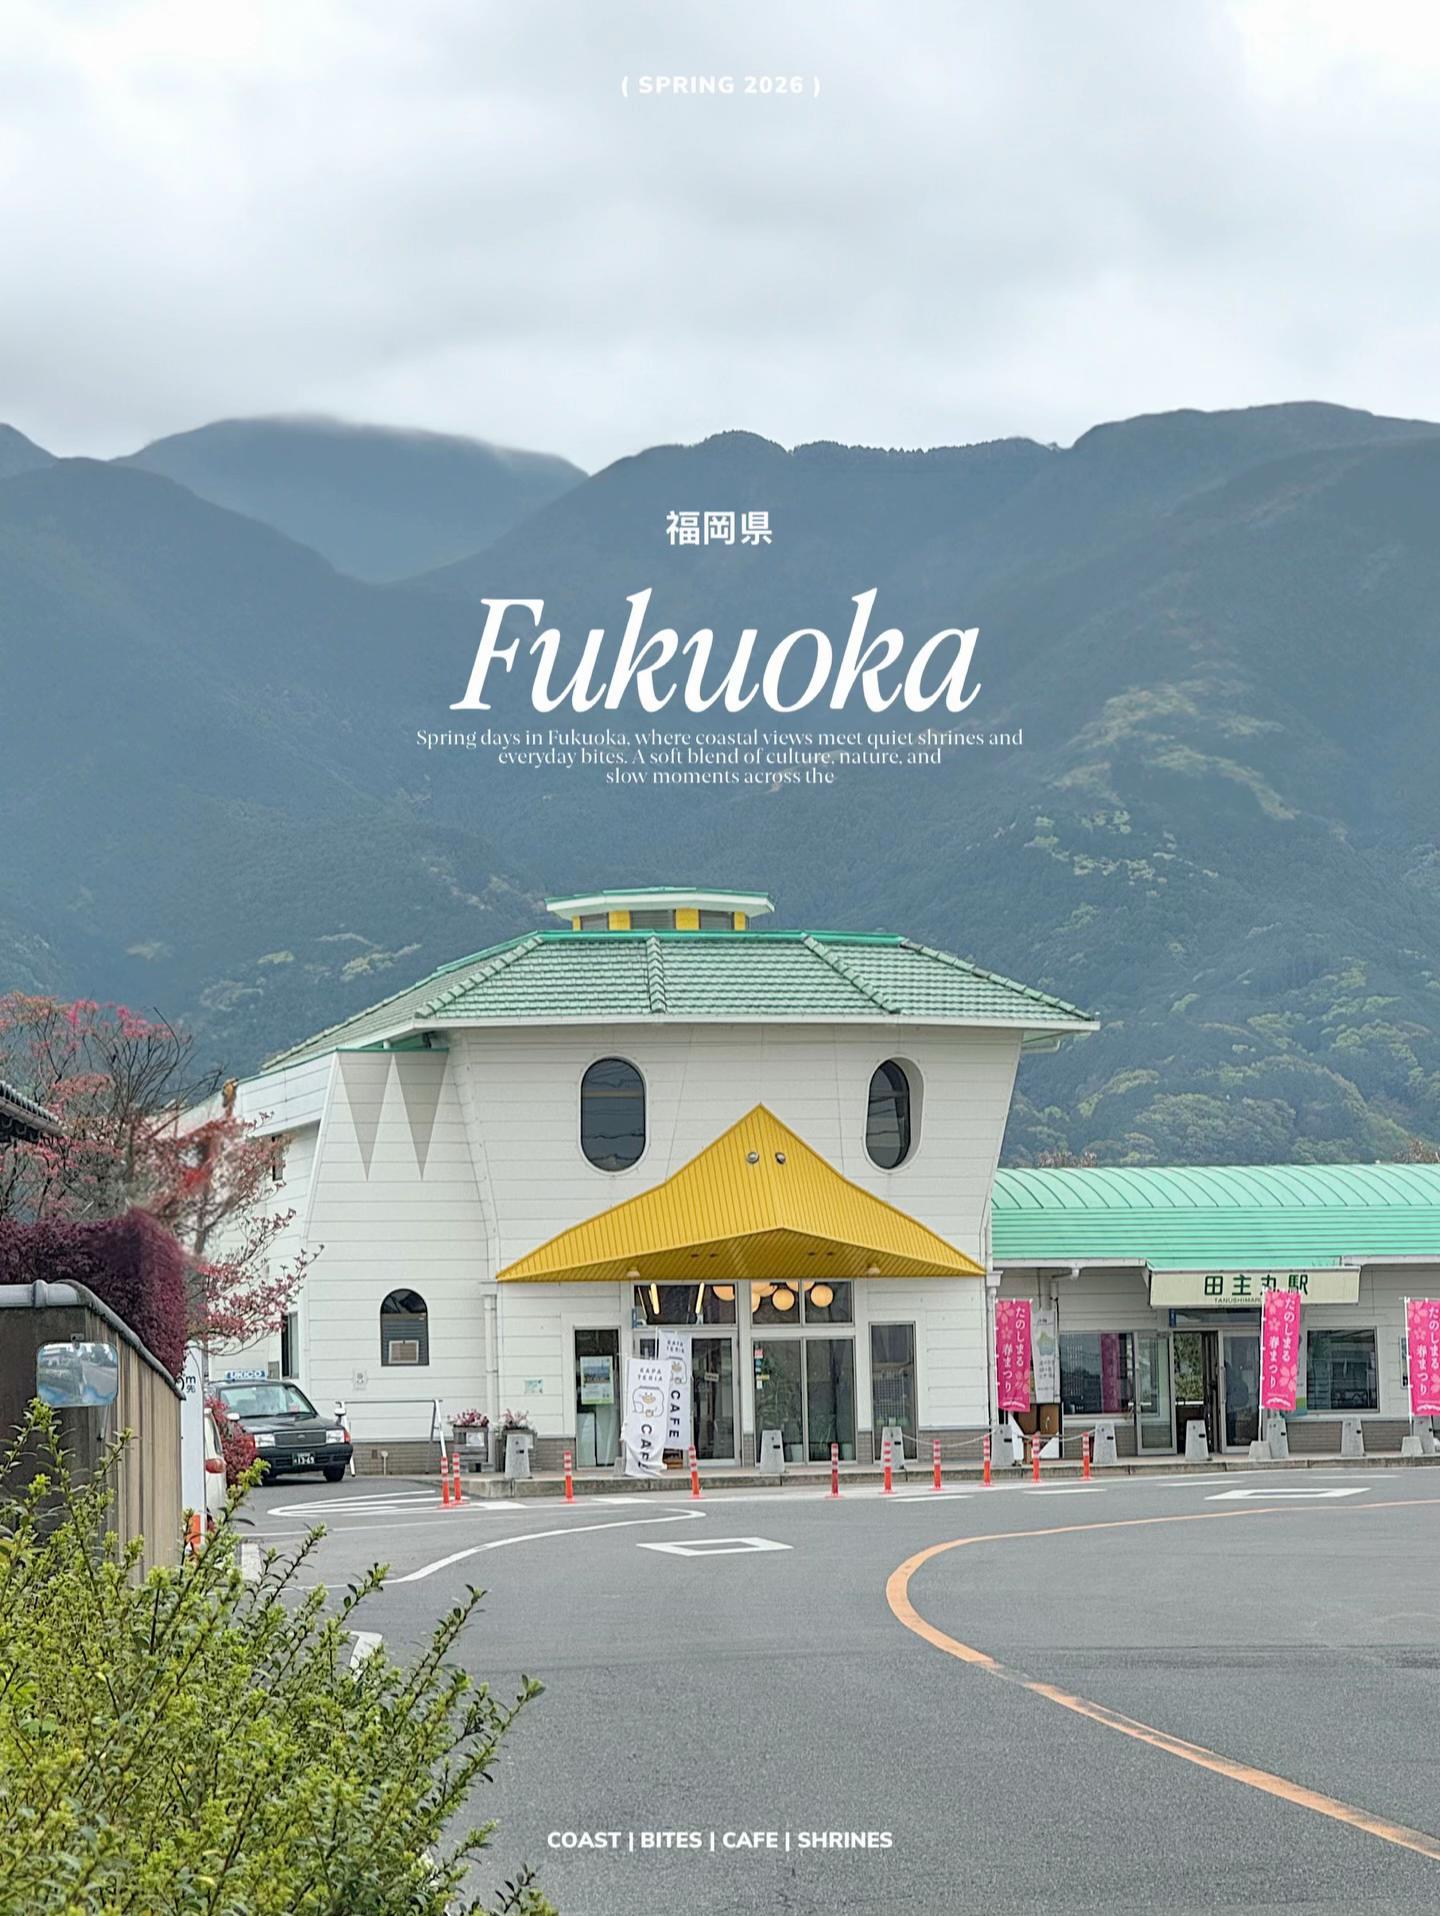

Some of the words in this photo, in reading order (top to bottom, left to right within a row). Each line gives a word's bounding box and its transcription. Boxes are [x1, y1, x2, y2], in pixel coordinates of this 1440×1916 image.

[1204, 1274, 1309, 1296] 田主丸駅
[1015, 1306, 1026, 1367] たのしまる
[1282, 1298, 1296, 1362] たのしまる
[1428, 1306, 1440, 1370] たのしまる
[1002, 1343, 1013, 1393] 春まつり
[1268, 1335, 1280, 1390] 春まつり
[1416, 1343, 1429, 1395] 春まつり
[668, 1390, 681, 1439] CAFE
